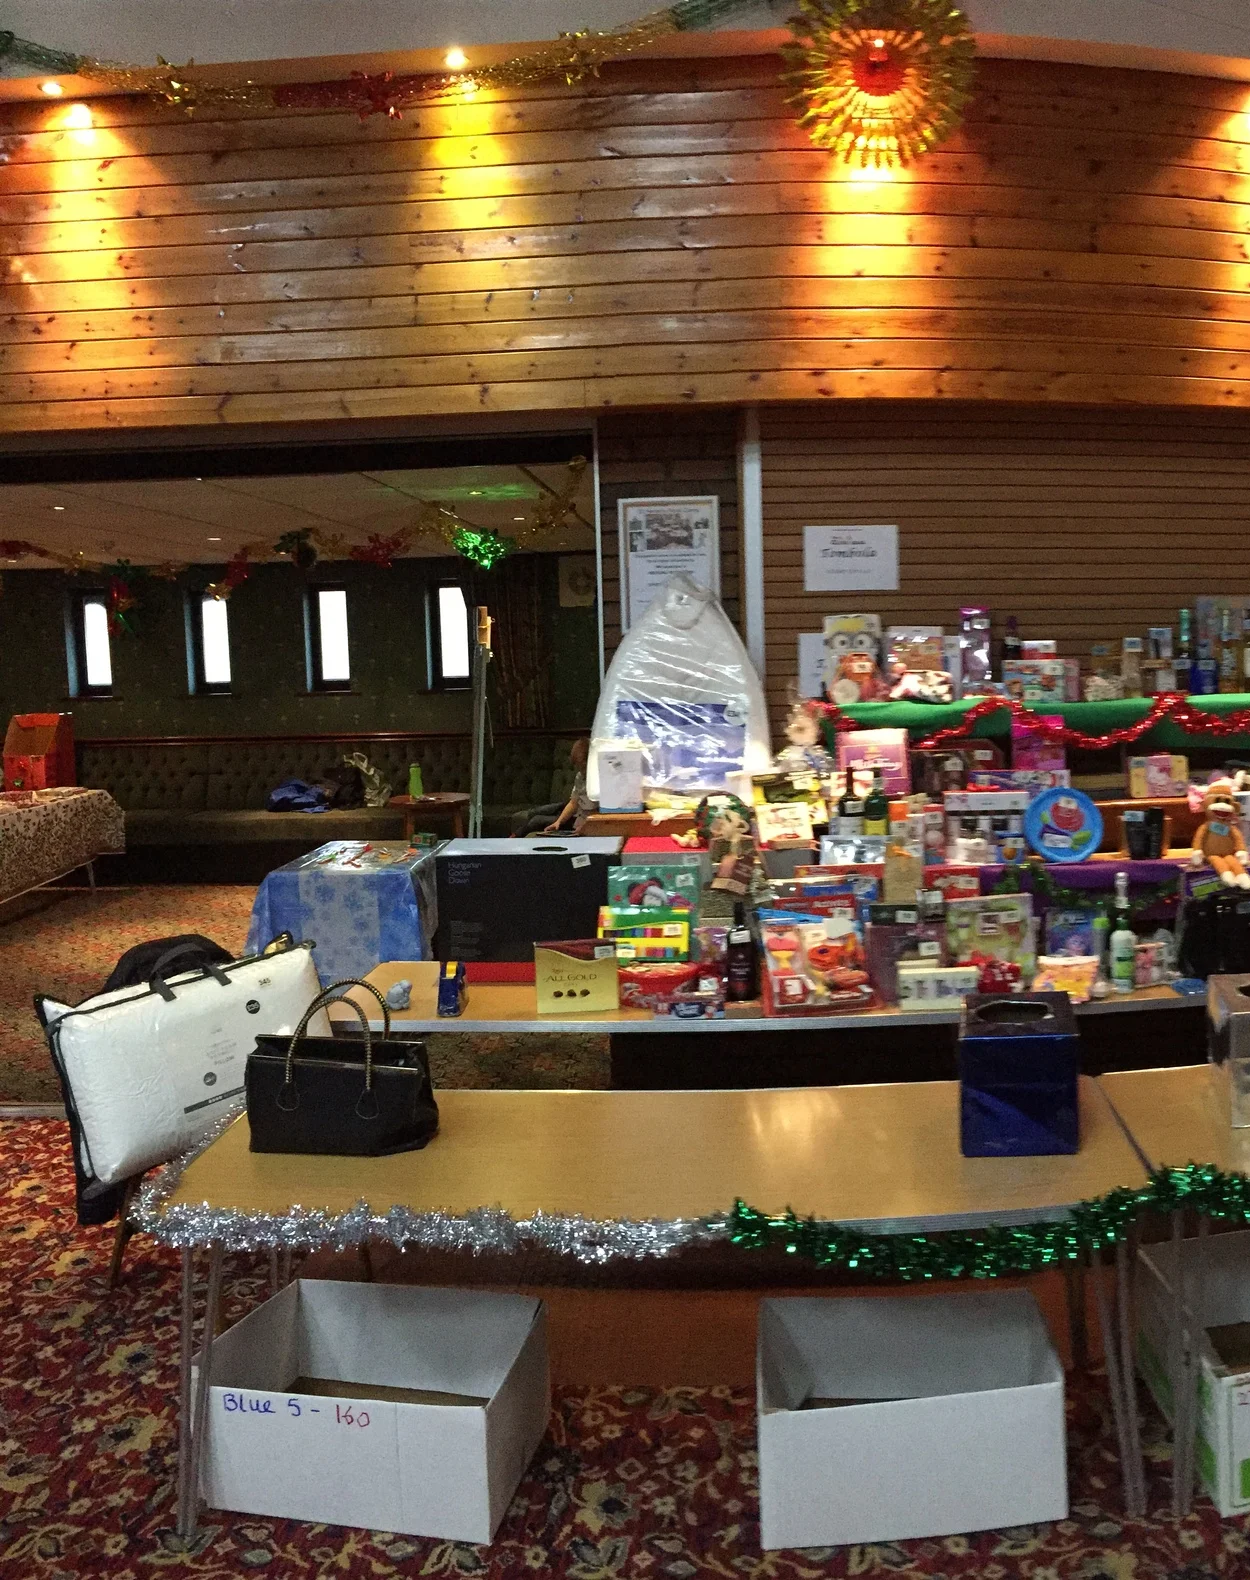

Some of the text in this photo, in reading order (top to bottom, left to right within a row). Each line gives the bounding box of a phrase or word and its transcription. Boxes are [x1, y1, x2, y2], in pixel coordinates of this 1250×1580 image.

[448, 861, 482, 870] Hungarian
[545, 973, 597, 983] ALL GOLD
[223, 1393, 276, 1414] Blue
[287, 1398, 301, 1417] 5
[335, 1404, 370, 1428] 160
